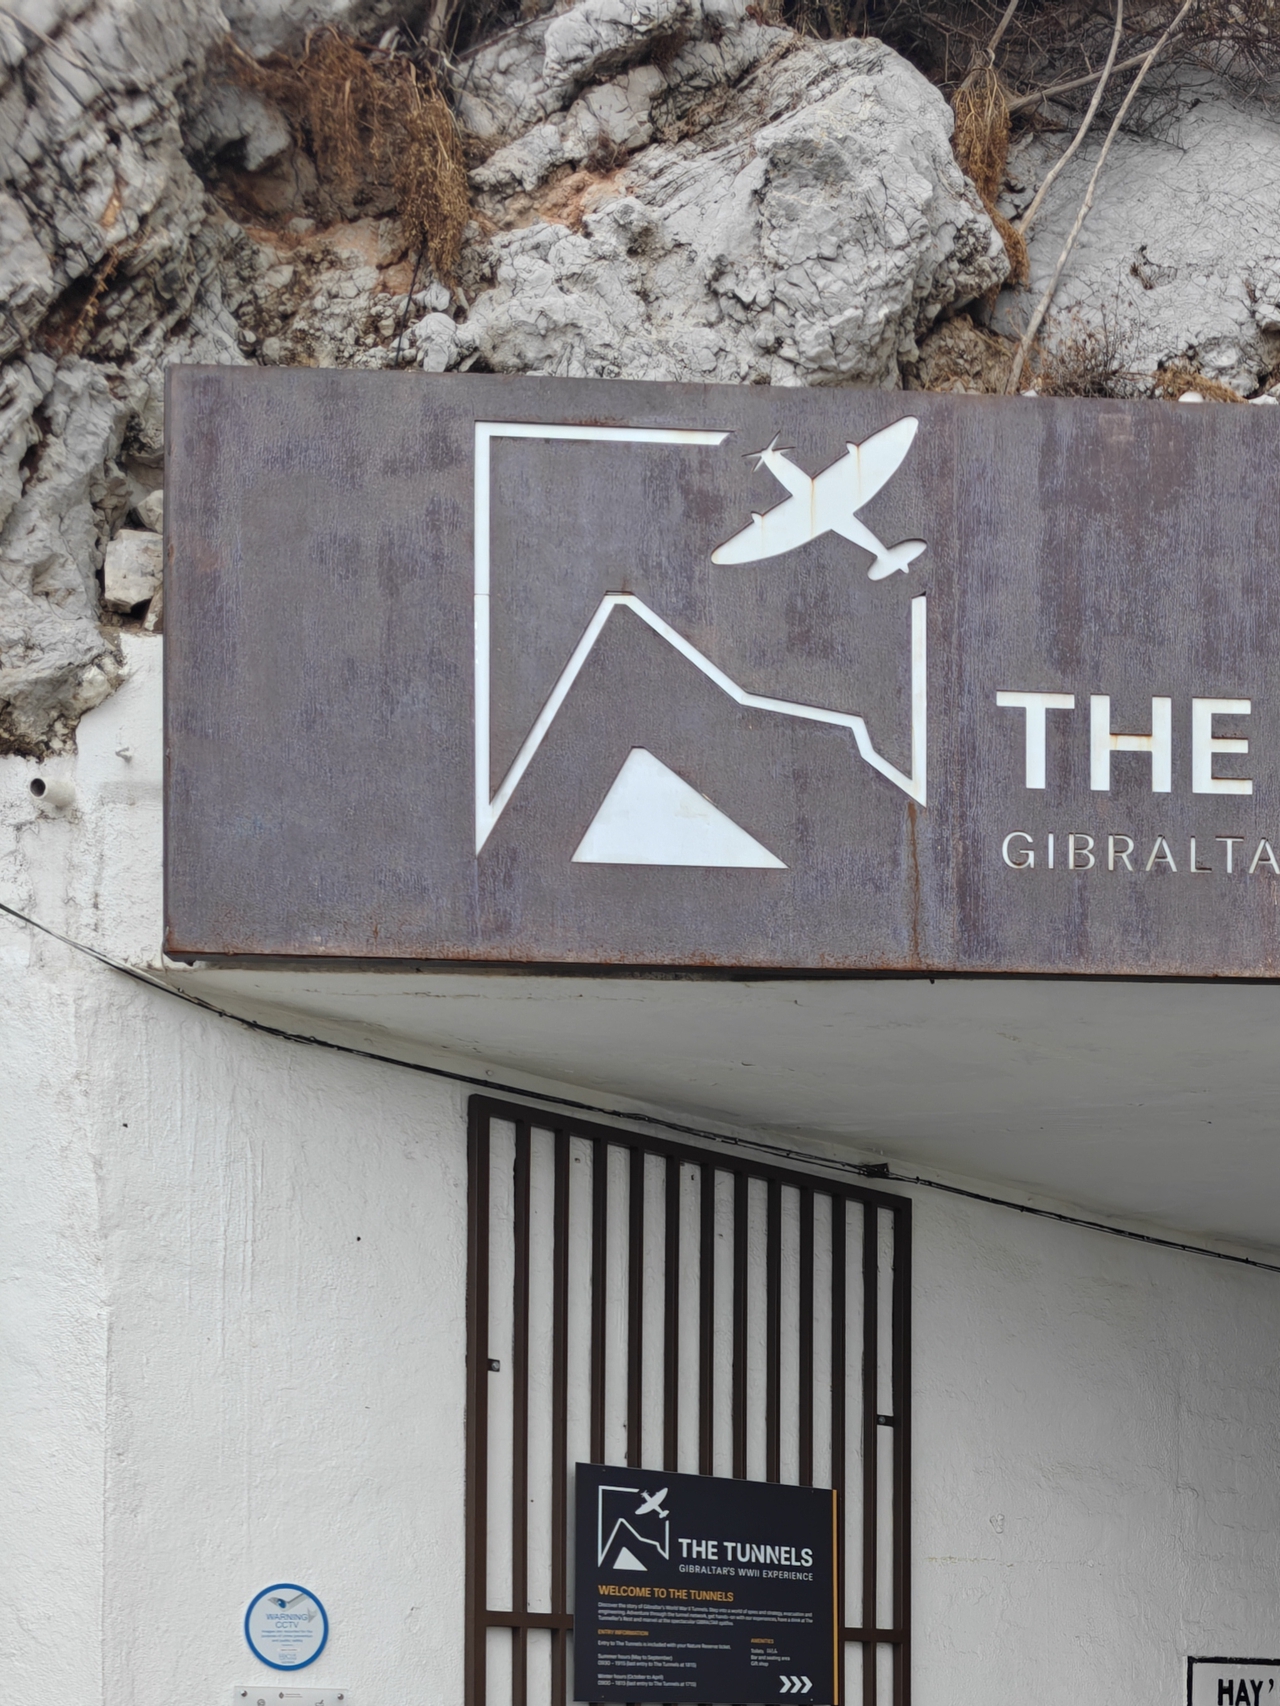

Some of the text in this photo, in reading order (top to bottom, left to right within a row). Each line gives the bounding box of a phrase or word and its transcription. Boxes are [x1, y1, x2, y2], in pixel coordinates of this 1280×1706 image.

[996, 692, 1252, 795] THE
[678, 1539, 813, 1566] THE TUNNELS
[679, 1564, 813, 1581] GIBRALTAR'S WWII EXPERIENCE
[598, 1585, 733, 1602] WELCOME TO THE TUNNELS
